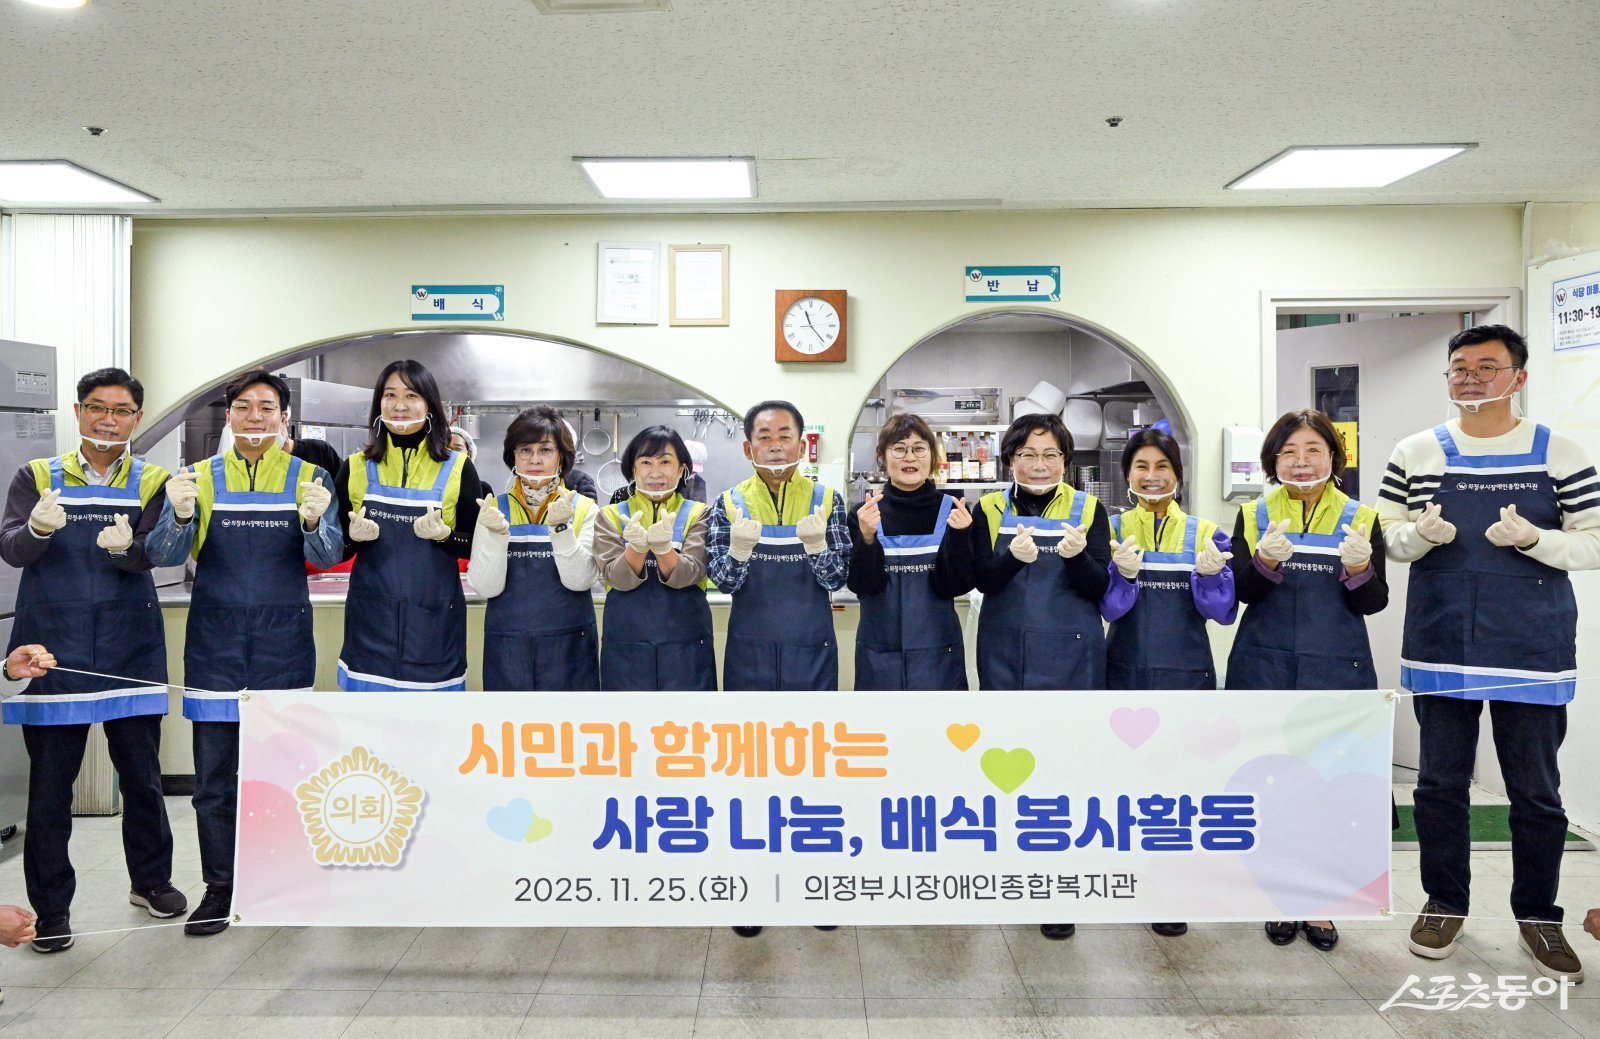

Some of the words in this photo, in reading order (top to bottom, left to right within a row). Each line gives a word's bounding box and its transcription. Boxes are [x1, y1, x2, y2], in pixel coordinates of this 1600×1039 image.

[987, 280, 1000, 292] 반
[1027, 280, 1039, 292] 납
[1572, 287, 1585, 298] 식당
[1586, 283, 1600, 296] 이용
[433, 299, 445, 310] 배
[472, 298, 484, 310] 식
[1468, 483, 1538, 492] 의정부시장애인종합복지관
[66, 513, 115, 522] 의정부시장애인종합
[378, 510, 419, 523] 의정부시장애인종합
[231, 520, 289, 528] 의정부시장애인종합복지관
[758, 553, 807, 562] 의정부시장애인종합복지
[460, 721, 638, 777] 시민과
[651, 720, 889, 777] 함께하는
[330, 794, 385, 824] 의회
[593, 795, 714, 852] 사랑
[729, 795, 862, 857] 나눔,
[881, 795, 997, 852] 배식
[1016, 794, 1256, 852] 봉사활동
[514, 877, 601, 902] 2025.
[610, 877, 638, 902] 11.
[649, 875, 748, 903] 25.(화)
[804, 873, 1138, 902] 의정부시장애인종합복지관
